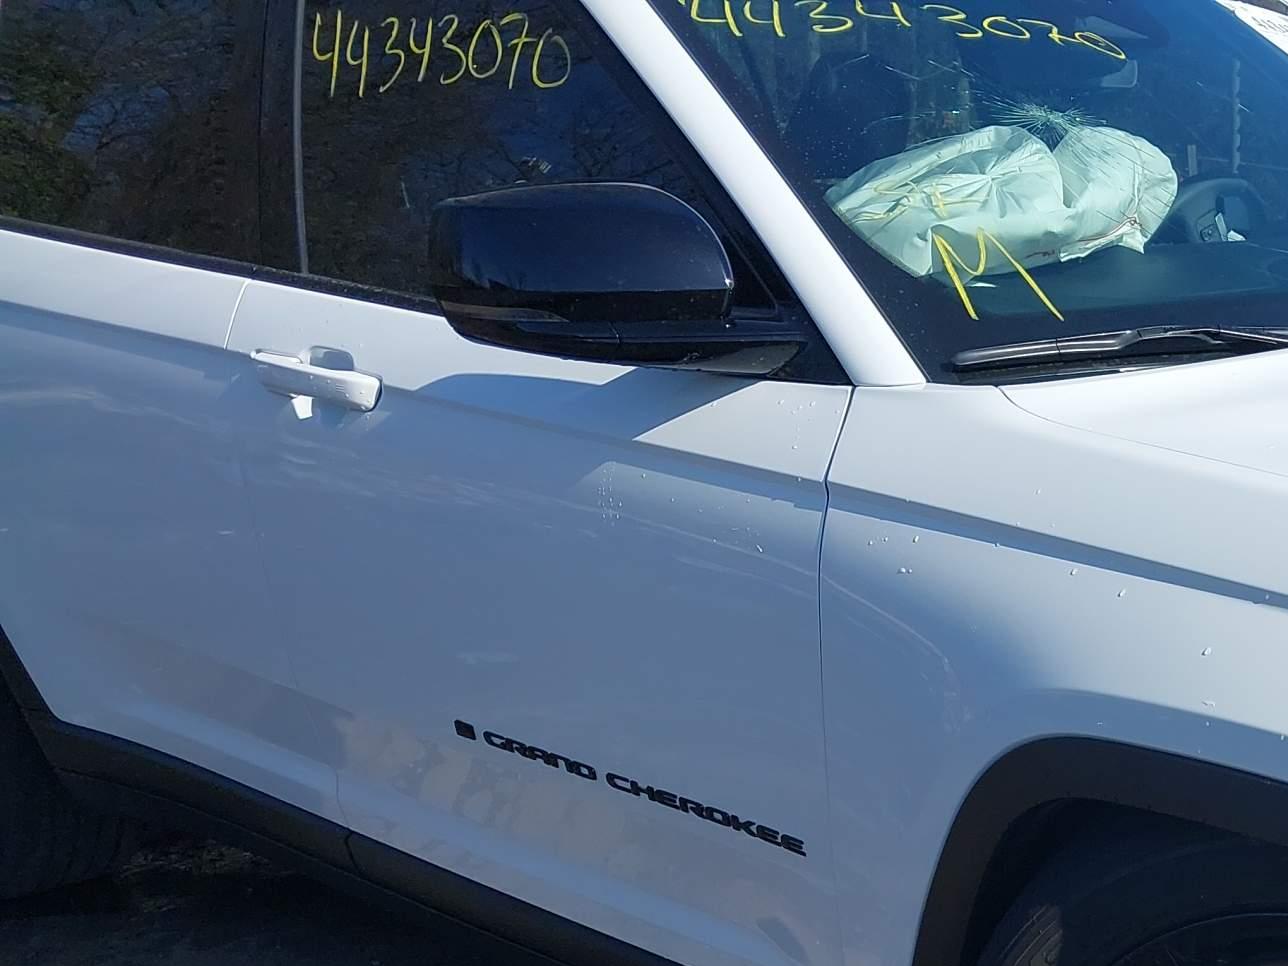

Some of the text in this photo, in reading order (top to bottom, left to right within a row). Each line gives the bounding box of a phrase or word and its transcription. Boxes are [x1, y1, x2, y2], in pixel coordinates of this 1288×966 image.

[312, 9, 571, 98] 44343070
[679, 0, 1128, 60] 44343070
[930, 226, 1065, 322] M
[483, 731, 807, 857] GRAND CHEROKEE
